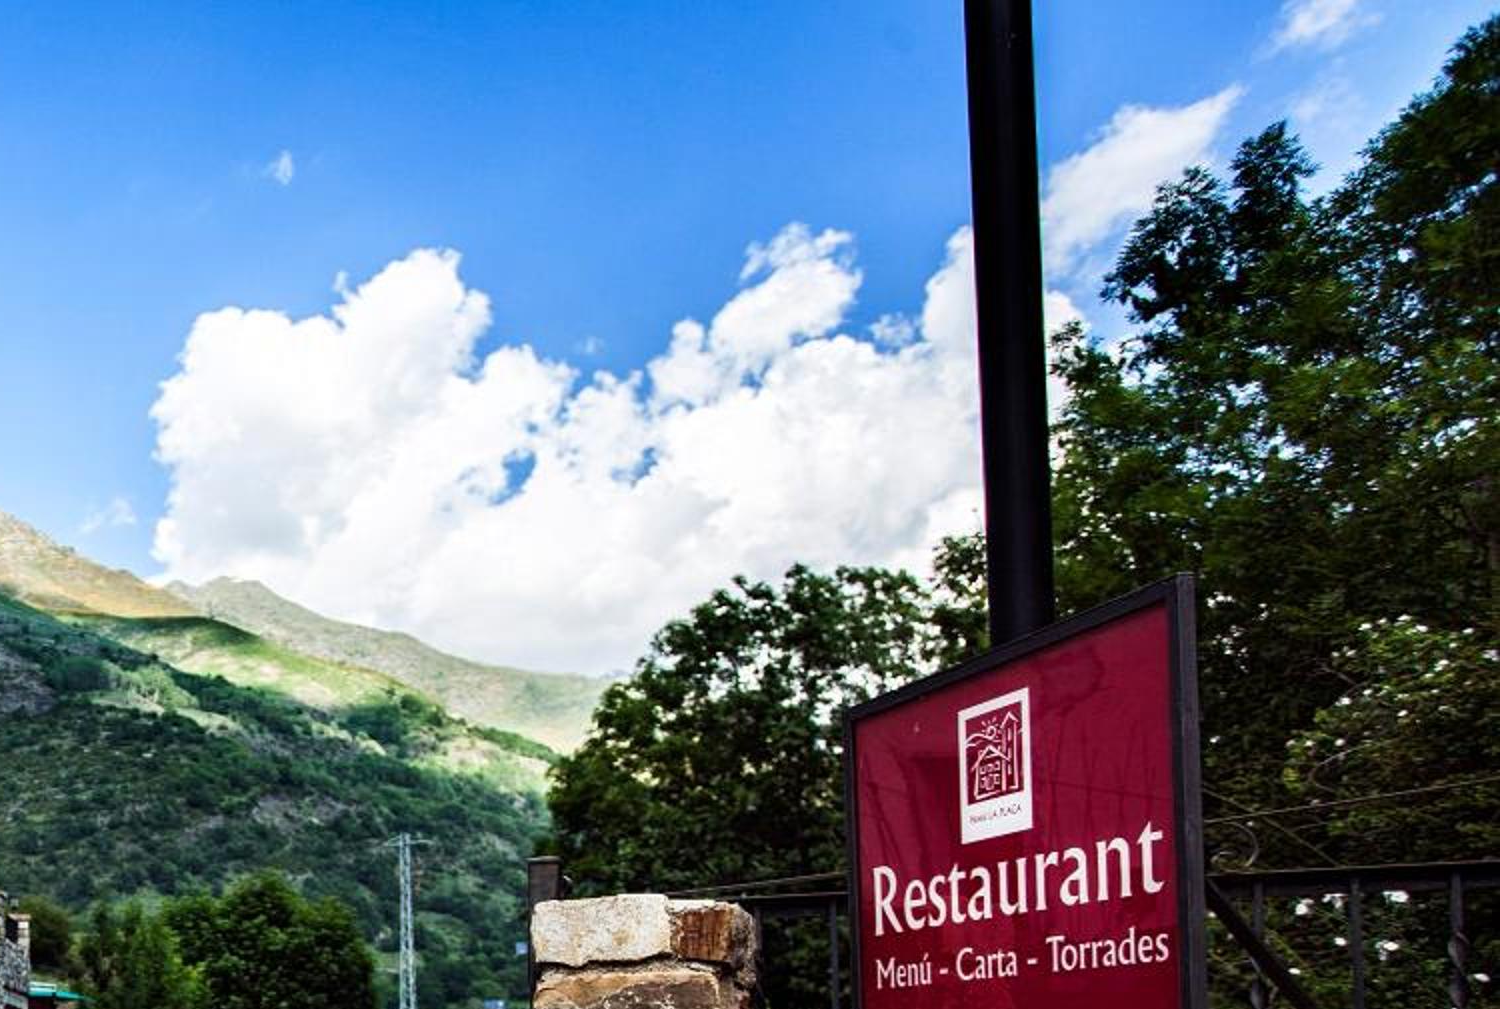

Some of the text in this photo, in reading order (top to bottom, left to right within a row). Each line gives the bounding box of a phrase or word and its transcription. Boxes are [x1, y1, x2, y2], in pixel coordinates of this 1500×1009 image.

[872, 820, 1165, 936] Restaurant
[876, 953, 932, 989] Menú
[956, 947, 1017, 980] Carta
[1046, 926, 1168, 972] Torrades
